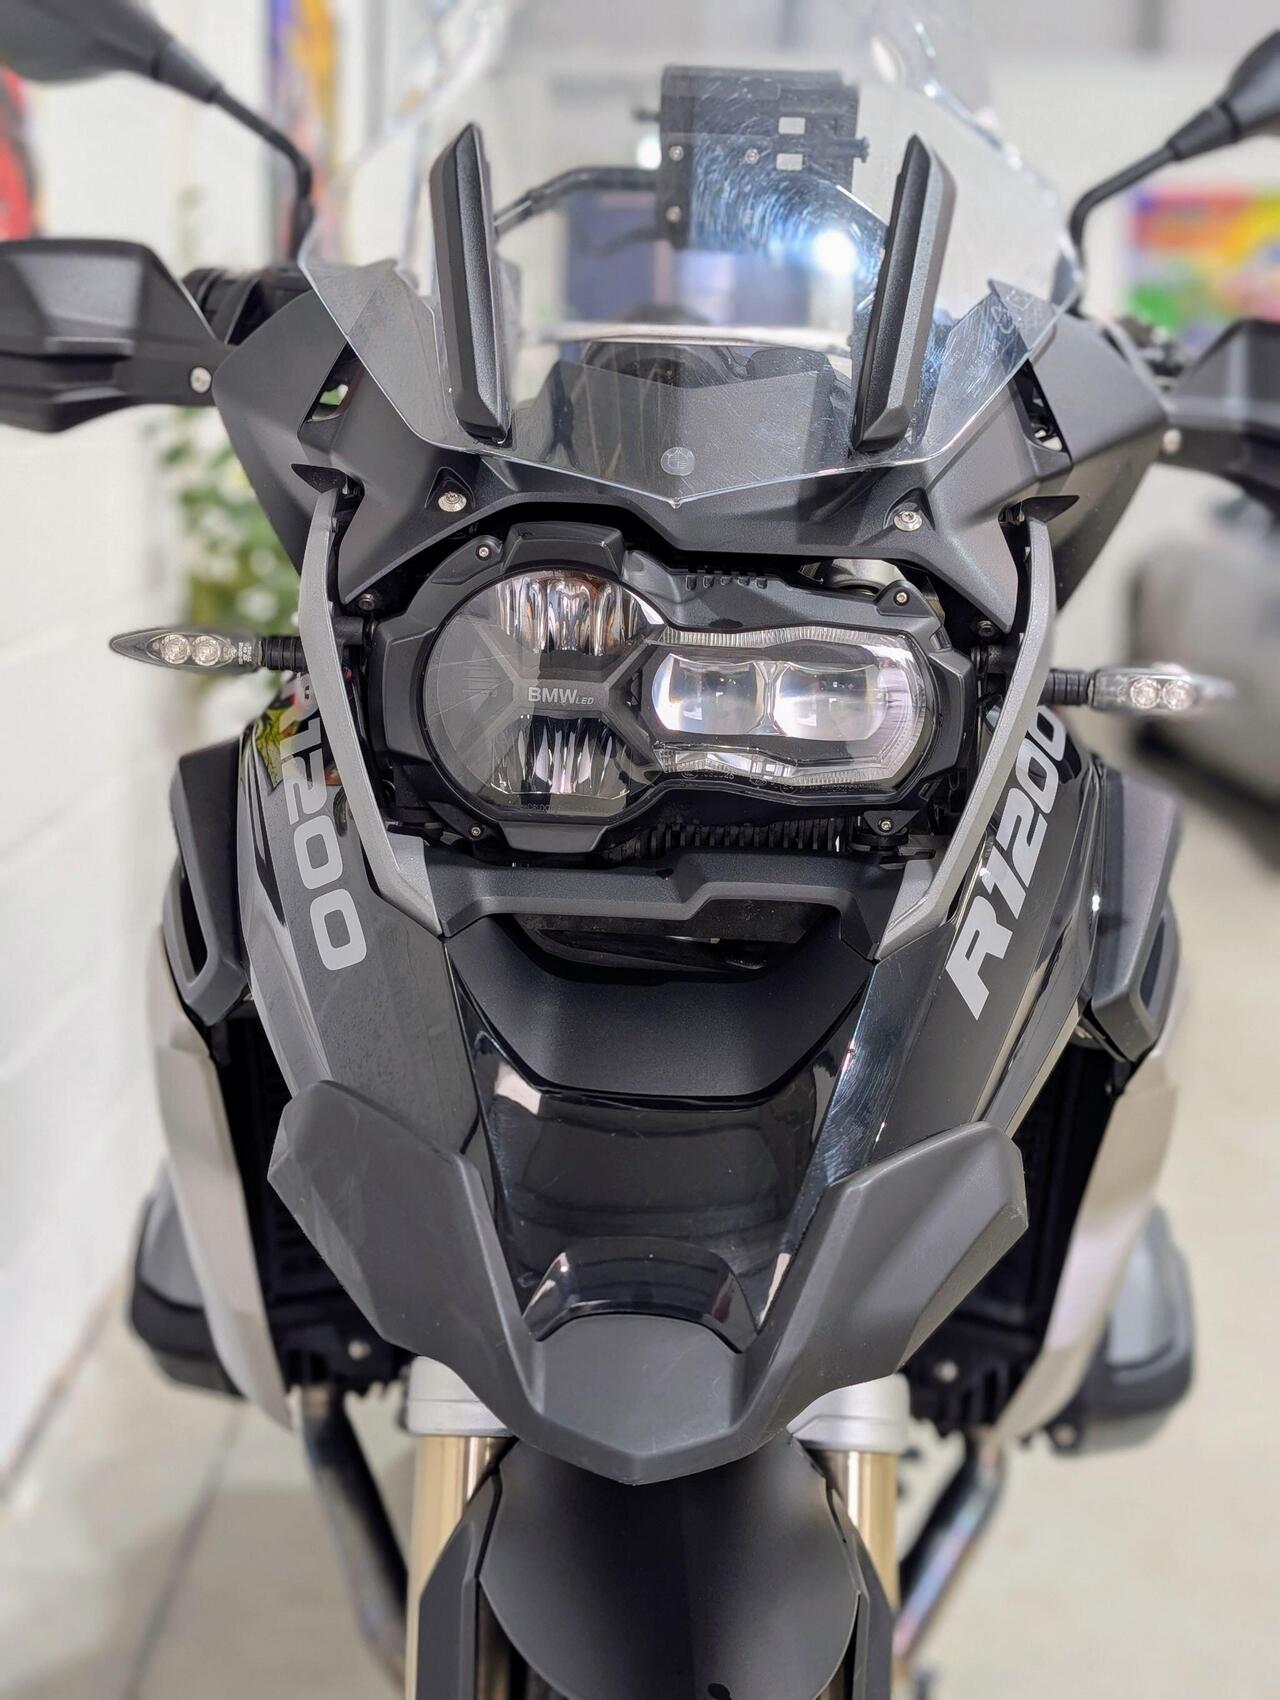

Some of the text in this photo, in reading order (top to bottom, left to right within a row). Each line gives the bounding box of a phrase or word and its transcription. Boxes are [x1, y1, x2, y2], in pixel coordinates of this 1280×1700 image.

[528, 687, 594, 705] BMW LED
[945, 704, 1067, 1021] R1200
